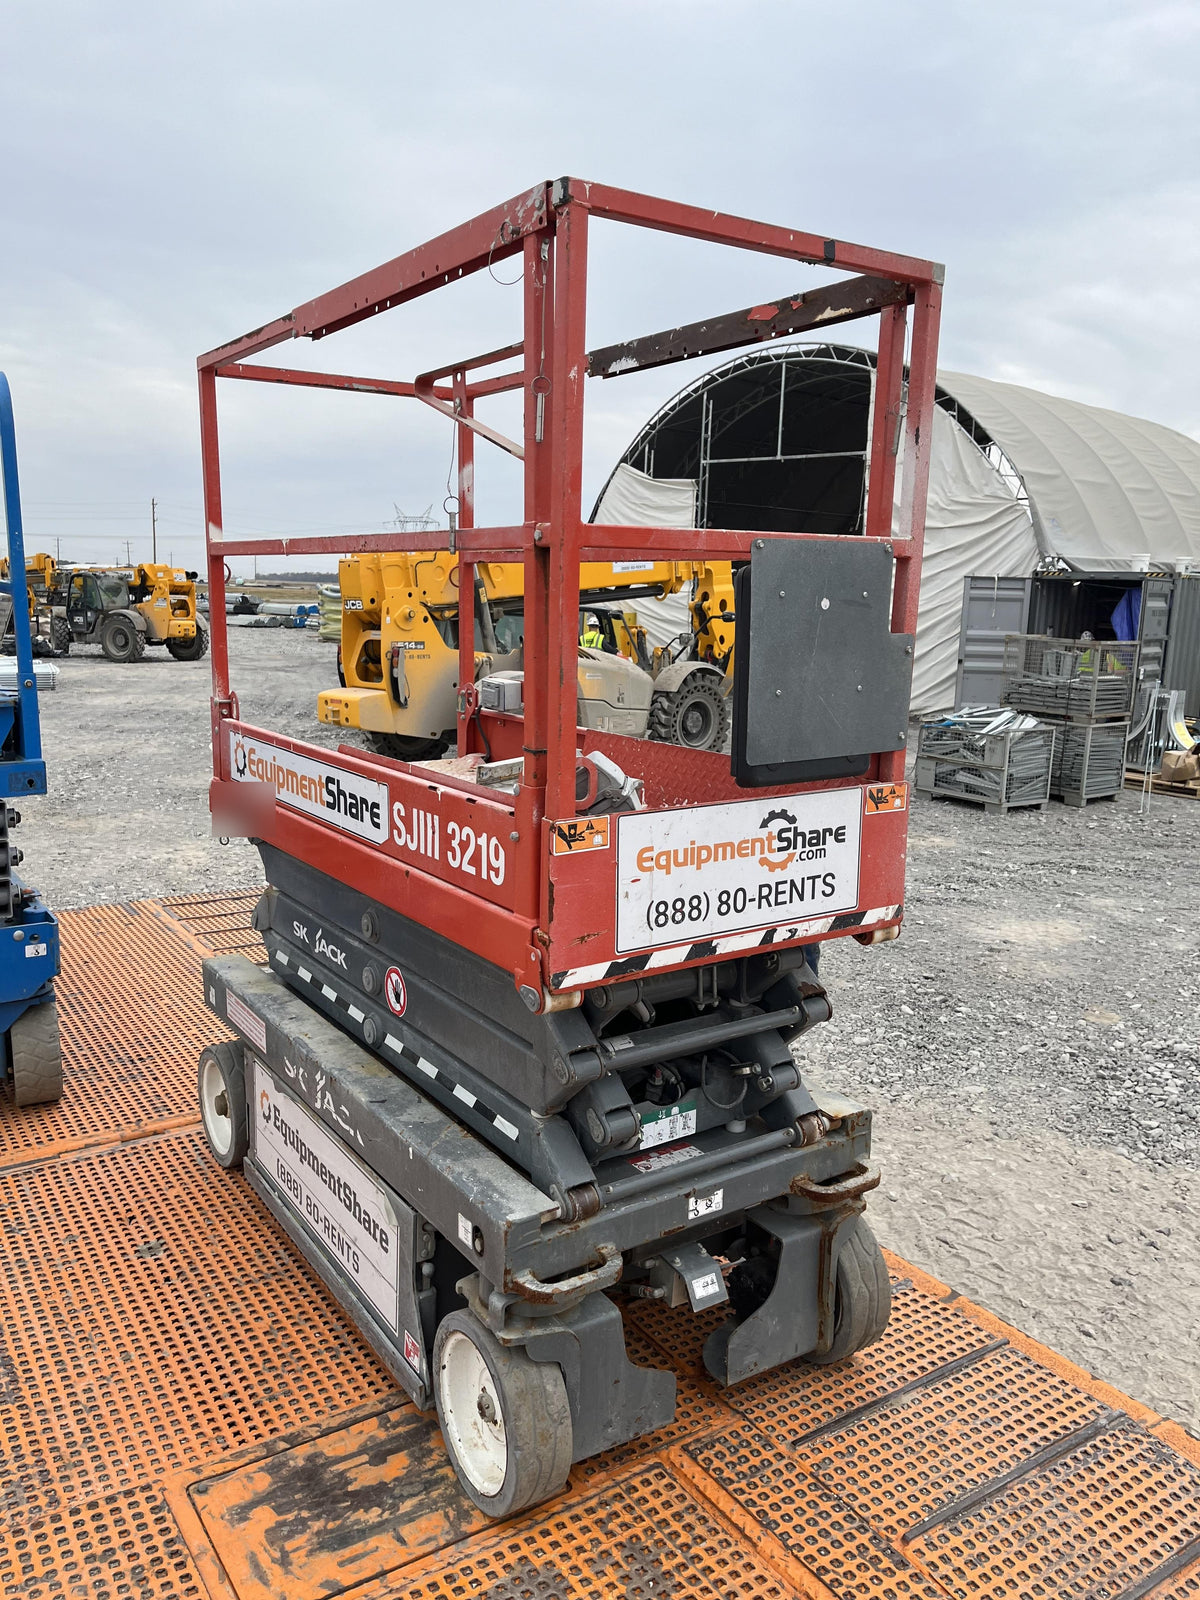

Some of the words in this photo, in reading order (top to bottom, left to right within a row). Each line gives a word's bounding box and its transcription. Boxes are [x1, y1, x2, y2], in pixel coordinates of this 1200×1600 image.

[344, 600, 363, 609] JCB
[247, 747, 381, 830] EquipmentShare
[392, 801, 440, 860] SJIII
[447, 821, 505, 886] 3219
[636, 825, 846, 875] EquipmentShare
[795, 847, 827, 862] .com
[646, 891, 710, 931] (888)
[717, 872, 836, 917] 80-RENTS
[273, 1104, 390, 1255] EquipmentShare
[276, 1158, 303, 1206] (888)
[305, 1194, 361, 1275] 80-RENTS
